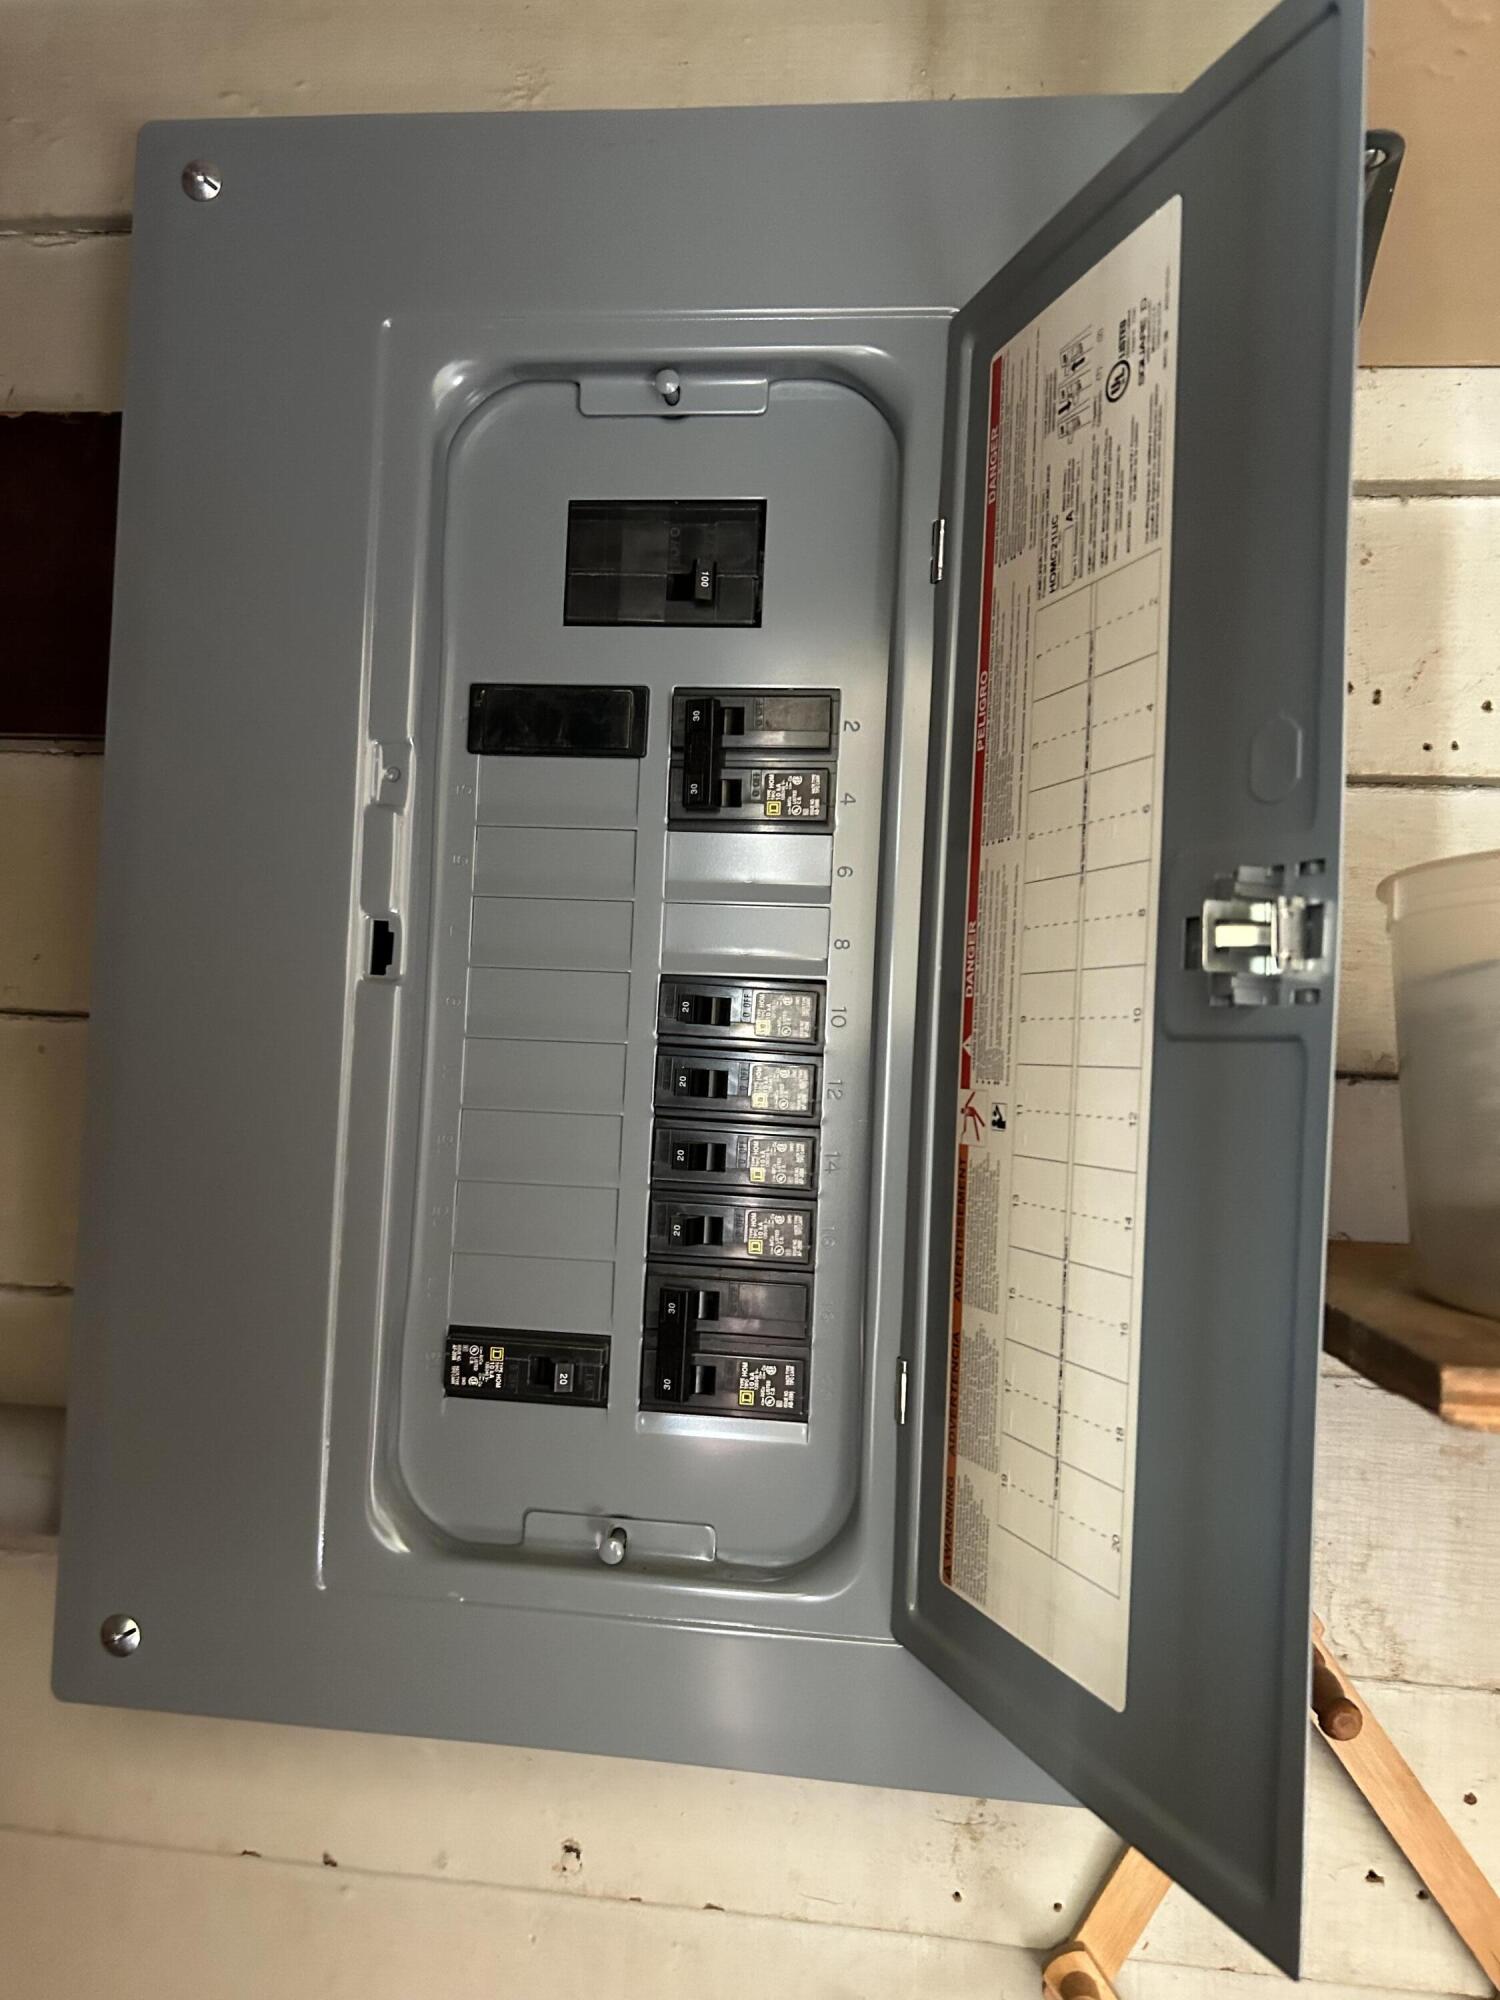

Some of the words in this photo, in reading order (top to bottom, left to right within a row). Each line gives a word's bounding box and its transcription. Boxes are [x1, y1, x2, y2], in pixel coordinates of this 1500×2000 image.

[1118, 319, 1127, 359] LISTED
[988, 425, 998, 504] DANGER
[1065, 510, 1073, 521] A
[700, 571, 710, 587] 100
[692, 710, 701, 721] 30
[975, 670, 988, 752] PELIGRO
[842, 719, 861, 734] 2
[690, 783, 698, 795] 30
[838, 792, 858, 807] 4
[836, 864, 854, 879] 6
[833, 938, 850, 950] 8
[965, 919, 978, 998] DANGER
[682, 1001, 690, 1013] 20
[743, 994, 751, 1007] OFF
[830, 1006, 848, 1029] 10
[1133, 1007, 1142, 1023] 10
[679, 1075, 687, 1087] 20
[826, 1080, 844, 1101] 12
[1016, 1102, 1023, 1117] 11
[1128, 1111, 1138, 1126] 12
[677, 1149, 685, 1162] 20
[823, 1152, 842, 1174] 14
[1012, 1193, 1020, 1208] 13
[673, 1224, 681, 1237] 20
[953, 1156, 968, 1303] AVERTISSEMENT
[1124, 1217, 1133, 1232] 14
[1008, 1286, 1016, 1300] 15
[668, 1302, 676, 1314] 30
[559, 1373, 568, 1385] 20
[663, 1378, 671, 1391] 30
[749, 1381, 755, 1389] 10
[1003, 1378, 1012, 1393] 17
[947, 1330, 961, 1457] ADVERTENCIA
[1115, 1426, 1125, 1444] 18
[1000, 1472, 1009, 1489] 19
[944, 1474, 956, 1564] WARNING
[1110, 1533, 1121, 1554] 20
